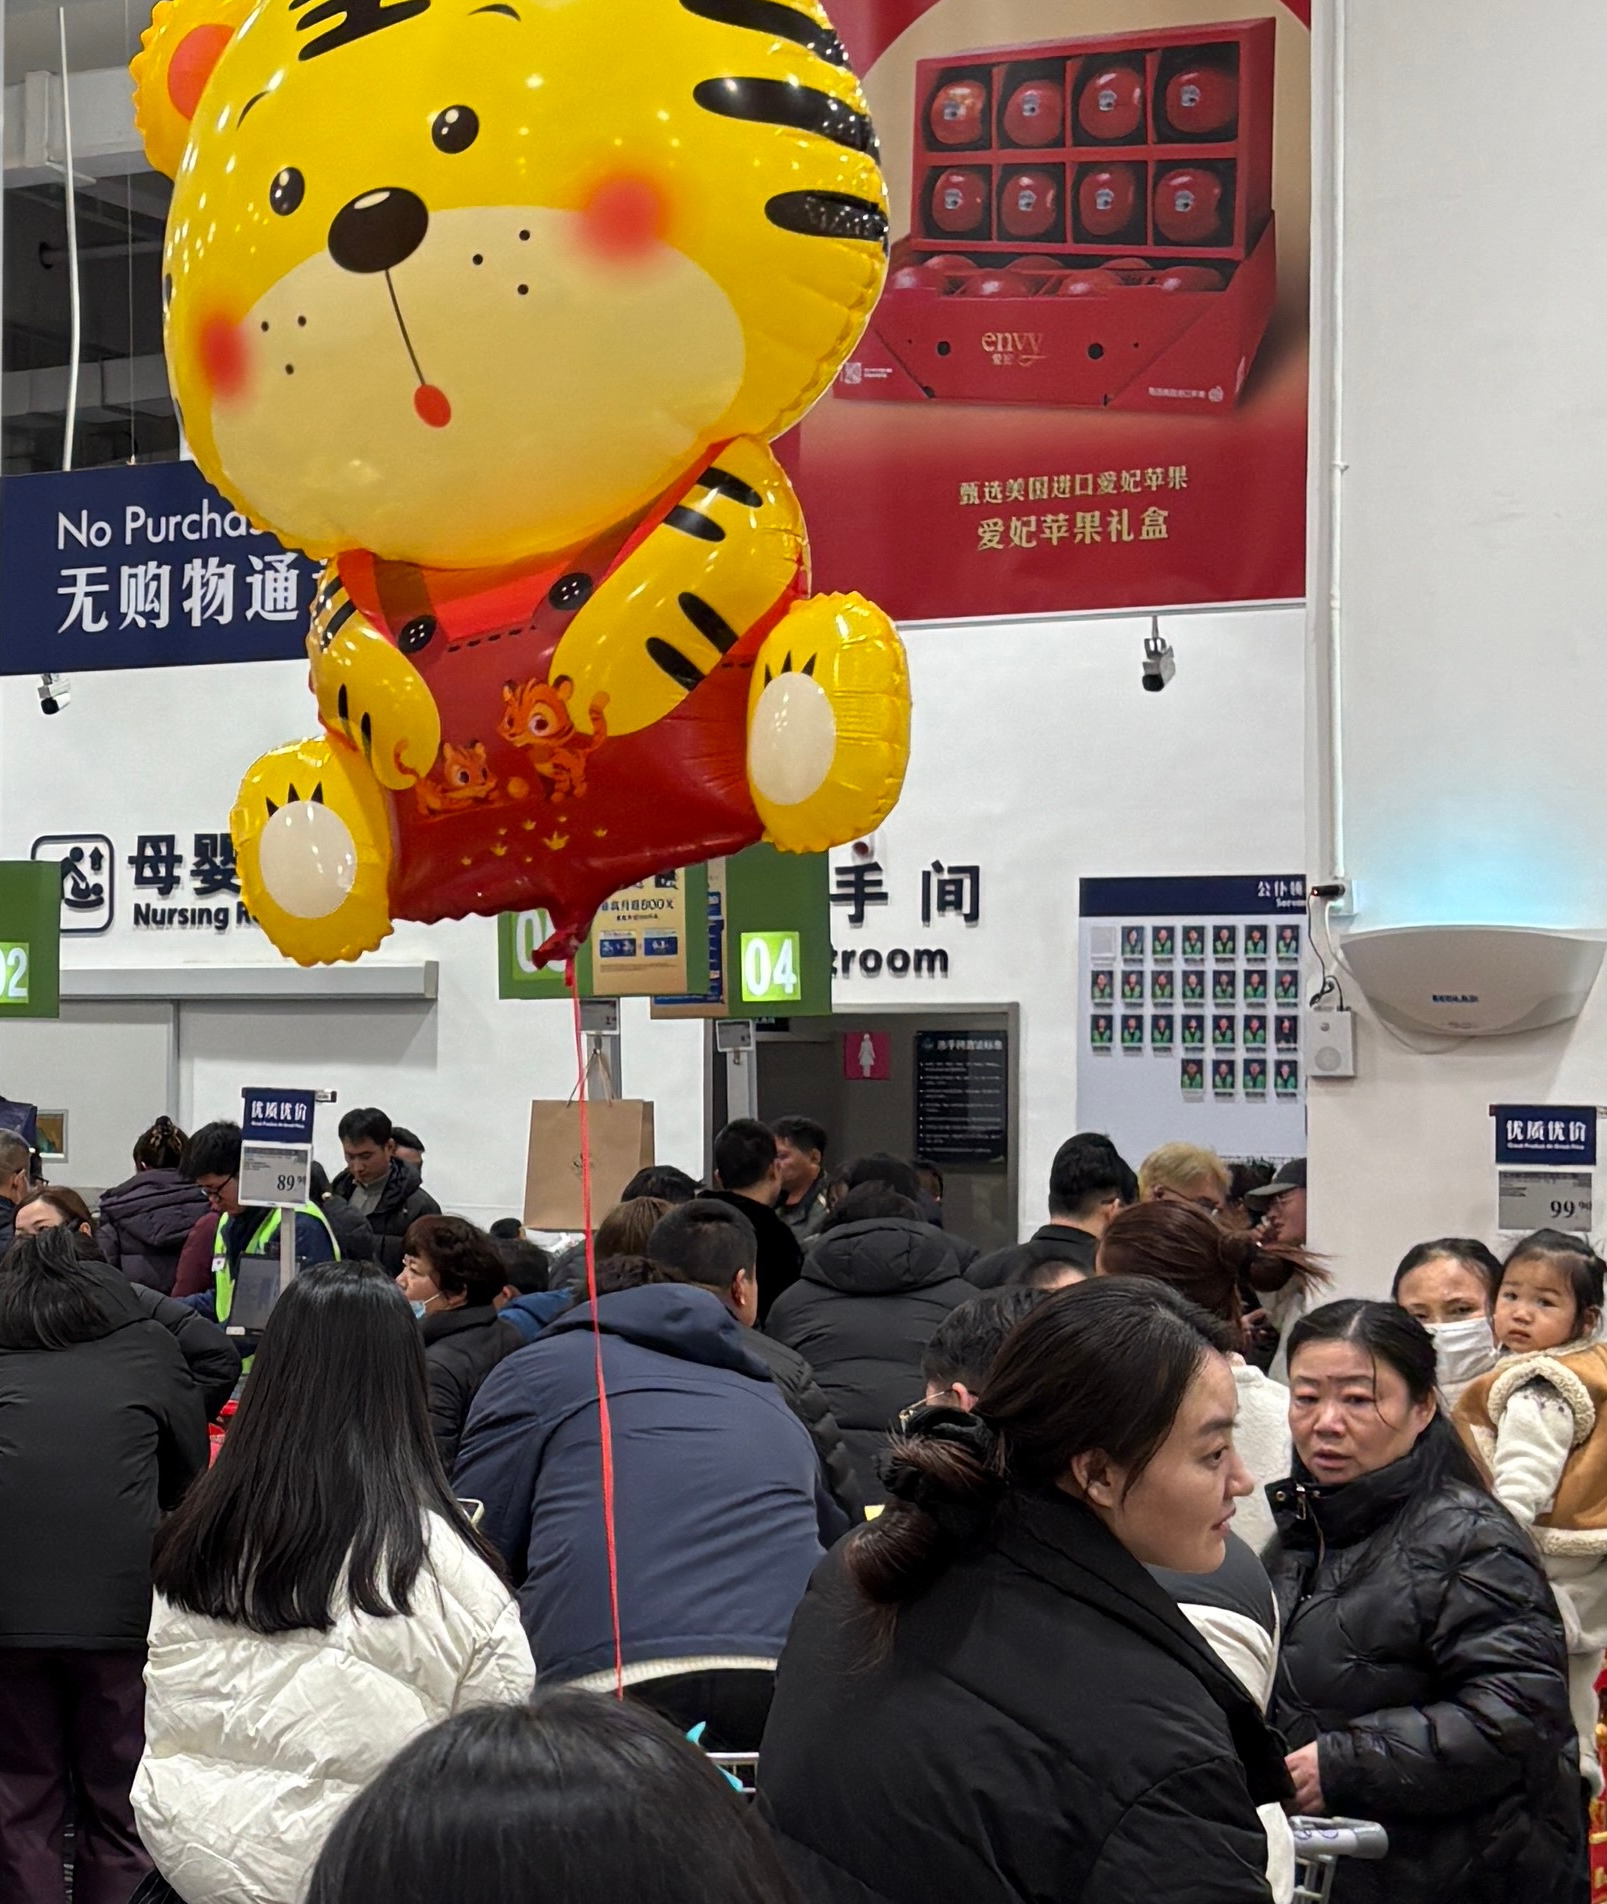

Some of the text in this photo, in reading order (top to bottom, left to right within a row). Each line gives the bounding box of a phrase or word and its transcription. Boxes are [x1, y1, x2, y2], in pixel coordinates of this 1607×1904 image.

[982, 331, 1043, 355] envy
[959, 465, 1189, 505] 甄选美国进口爱妃苹果
[58, 509, 112, 550] No
[977, 506, 1170, 551] 爱妃苹果礼盒
[57, 552, 328, 634] 无购物通
[133, 902, 230, 930] Nursing
[744, 941, 795, 996] 04
[277, 1174, 294, 1191] 89
[1550, 1200, 1575, 1218] 99
